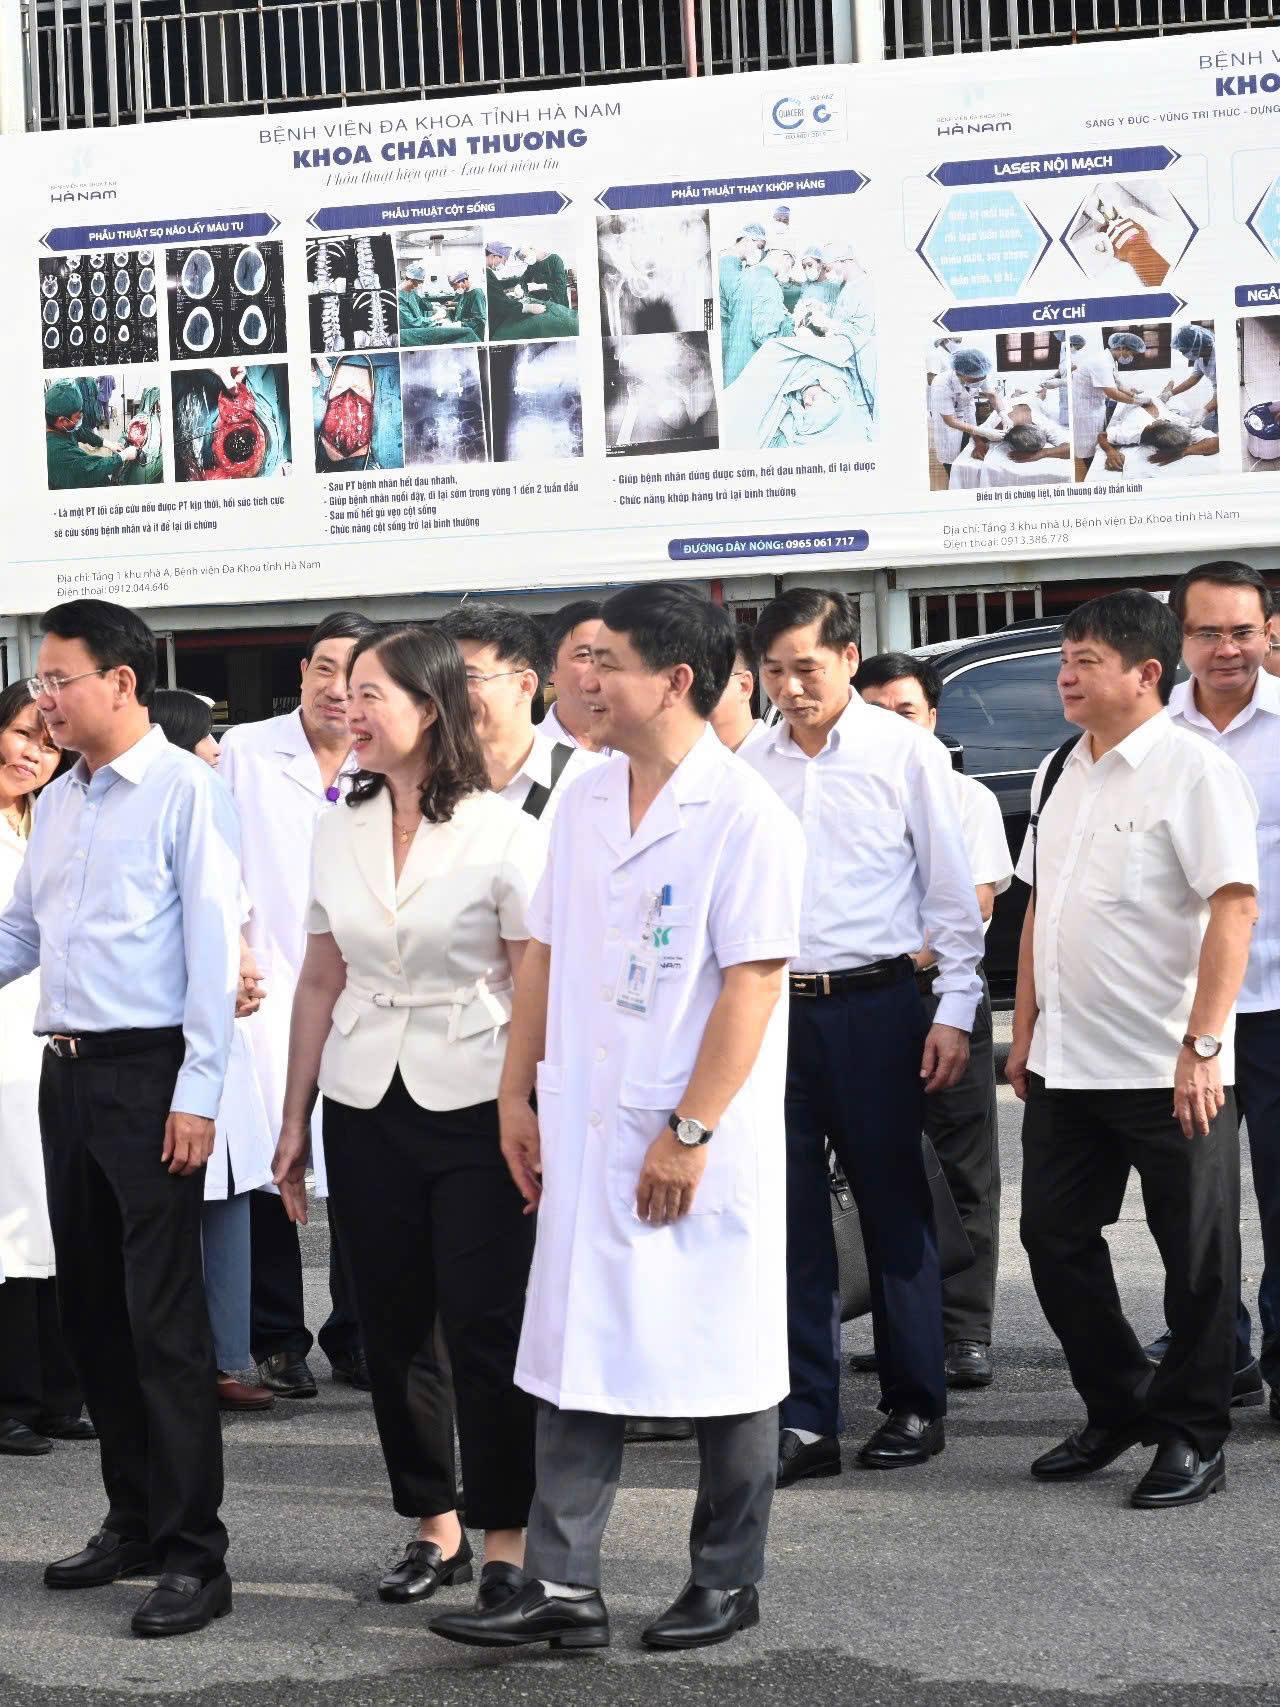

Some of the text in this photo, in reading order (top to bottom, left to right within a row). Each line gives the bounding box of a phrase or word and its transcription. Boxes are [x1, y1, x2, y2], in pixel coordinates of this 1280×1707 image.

[1199, 50, 1263, 71] BỆNH
[260, 103, 620, 144] BỆNH VIỆN ĐA KHOA TỈNH HÀ NAM
[938, 121, 1012, 136] HÀ NAM
[294, 129, 587, 168] KHOA CHẤN THƯƠNG
[994, 156, 1112, 175] LASER NỘI MẠCH
[702, 185, 735, 196] THUẬT
[737, 184, 764, 193] THAY
[766, 181, 794, 192] KHỚP
[796, 179, 825, 189] HÁNG
[51, 189, 117, 203] HÀ NAM
[411, 206, 443, 217] THUẬT
[445, 204, 464, 216] CỘT
[467, 201, 495, 213] SỐNG
[117, 228, 148, 239] THUẬT
[150, 228, 163, 238] SỌ
[188, 222, 205, 233] LẤY
[207, 222, 229, 232] MÁU
[231, 222, 243, 231] TỤ
[1247, 286, 1280, 302] NGÂ
[1033, 304, 1085, 320] CẤY CHỈ
[329, 483, 343, 491] Sau
[346, 481, 355, 490] PT
[469, 489, 489, 497] trong
[86, 507, 95, 515] PT
[330, 511, 344, 520] Sau
[1019, 521, 1037, 530] khu
[1216, 510, 1239, 519] Nam
[684, 537, 854, 553] ĐƯỜNG DÂY NÓNG: 0965 061 717
[299, 561, 320, 569] Nam
